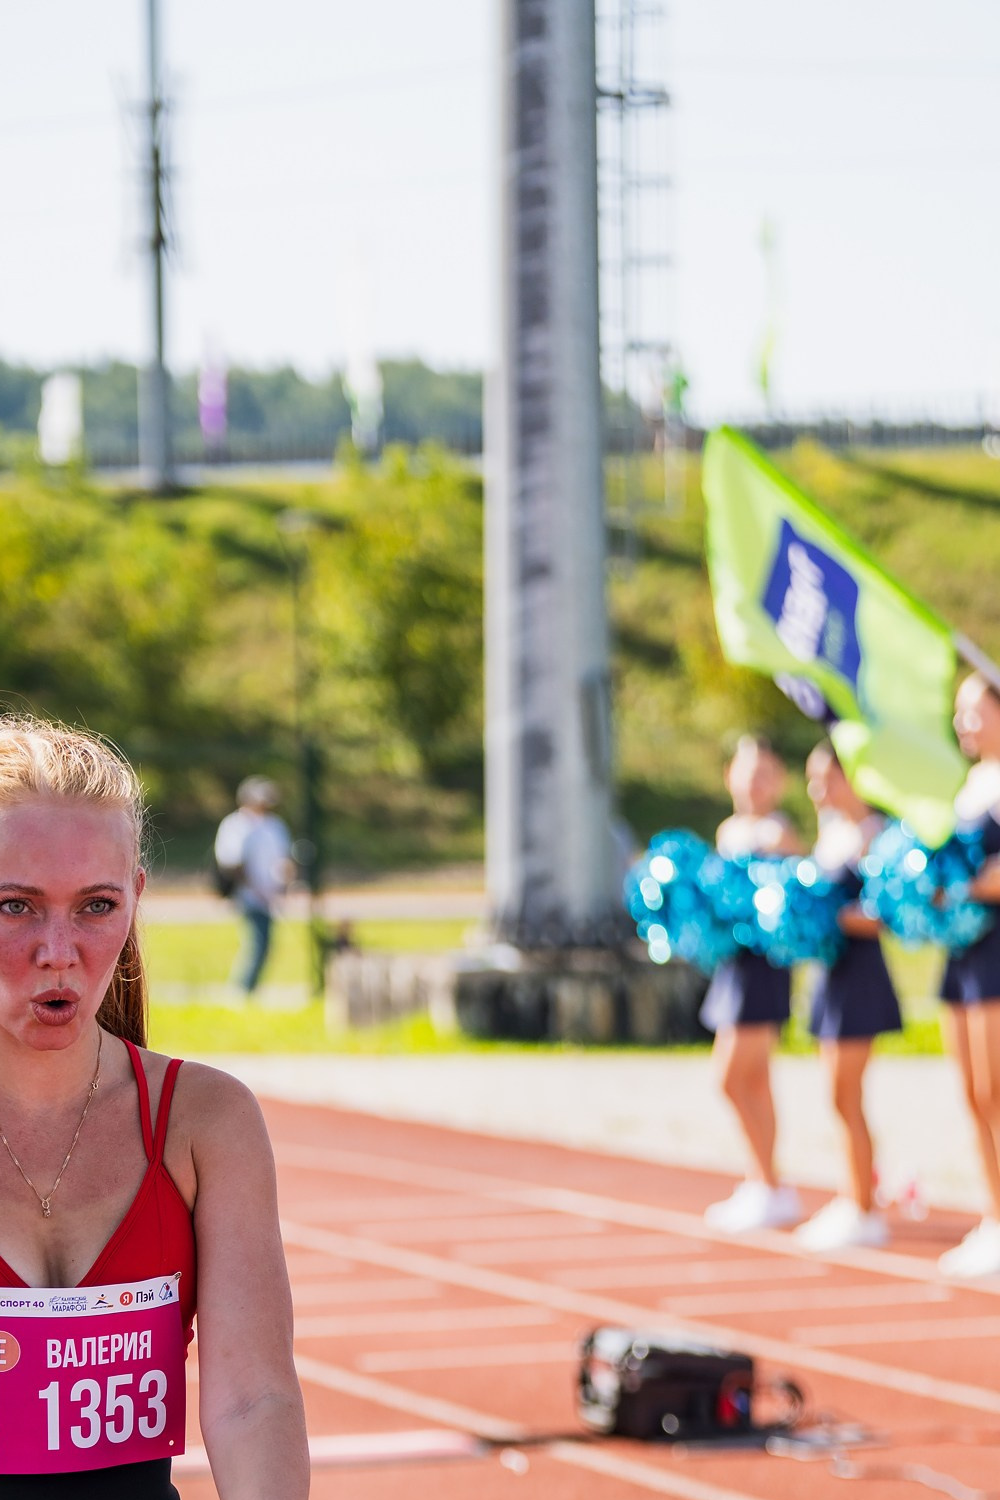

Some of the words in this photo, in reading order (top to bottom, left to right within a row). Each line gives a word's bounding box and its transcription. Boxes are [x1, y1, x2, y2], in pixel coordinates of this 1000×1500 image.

[136, 1289, 154, 1303] Пэй
[0, 1300, 31, 1308] СПОРТ
[32, 1300, 45, 1308] 40
[51, 1304, 87, 1312] МАРАФОН
[46, 1329, 152, 1369] ВАЛЕРИЯ
[38, 1369, 168, 1451] 1353
